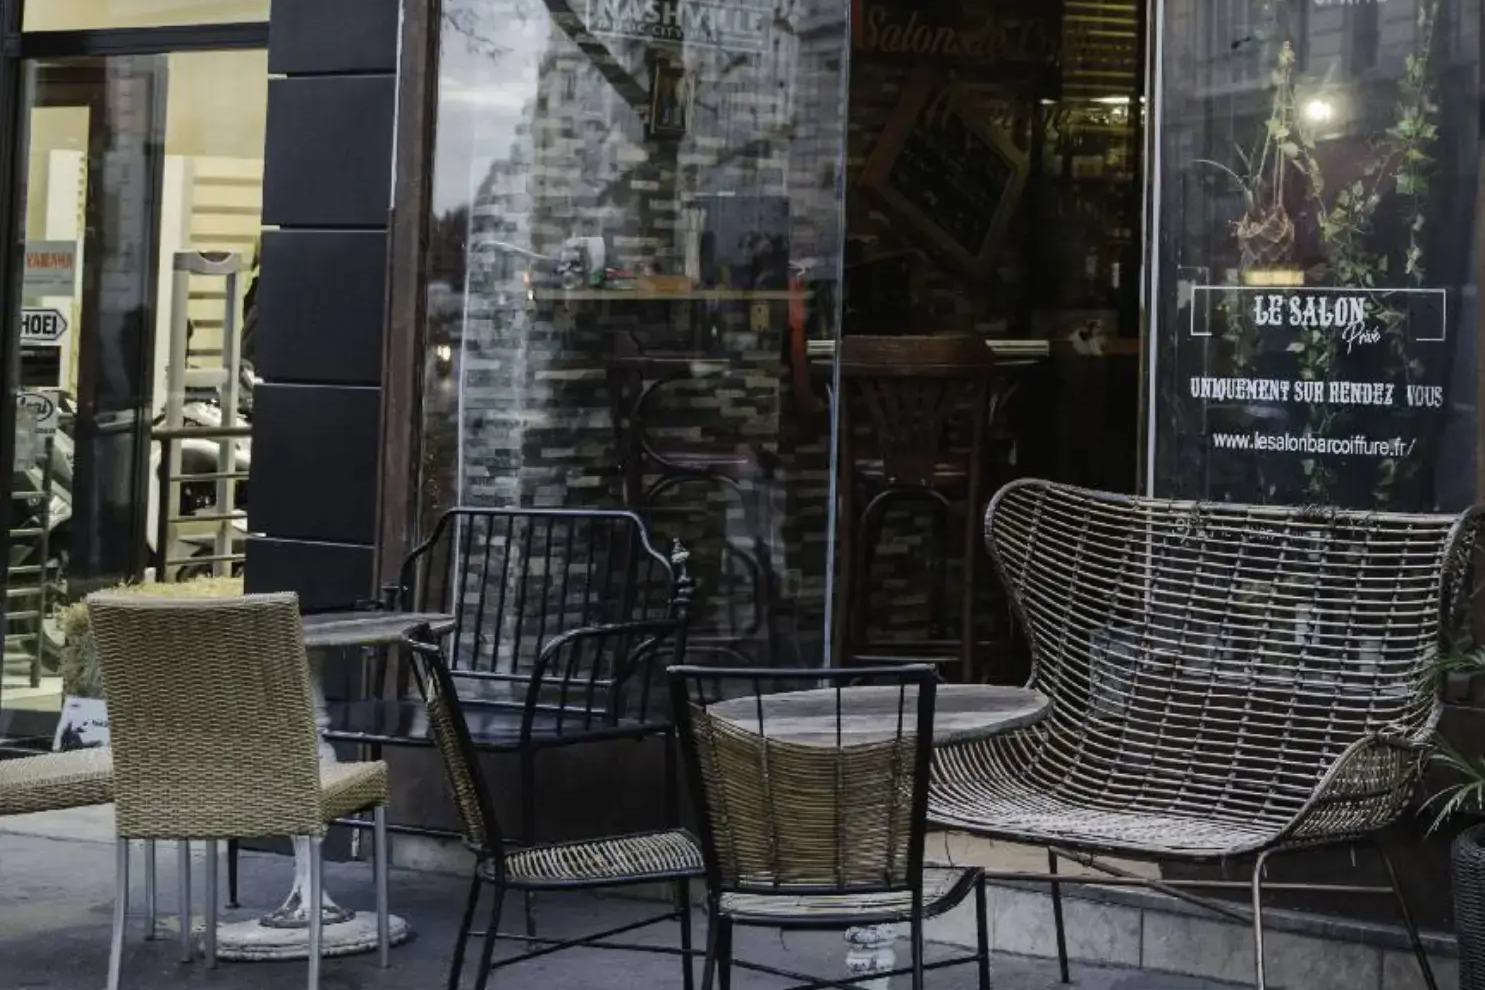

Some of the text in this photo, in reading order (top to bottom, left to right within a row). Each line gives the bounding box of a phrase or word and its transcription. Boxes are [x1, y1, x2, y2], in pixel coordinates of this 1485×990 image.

[1254, 295, 1366, 328] LE SALON
[1190, 377, 1444, 407] UNIQUEMENT SUR RENDEZ VOUS
[1212, 431, 1416, 457] www.lesalonbarcoiffure.fr/
